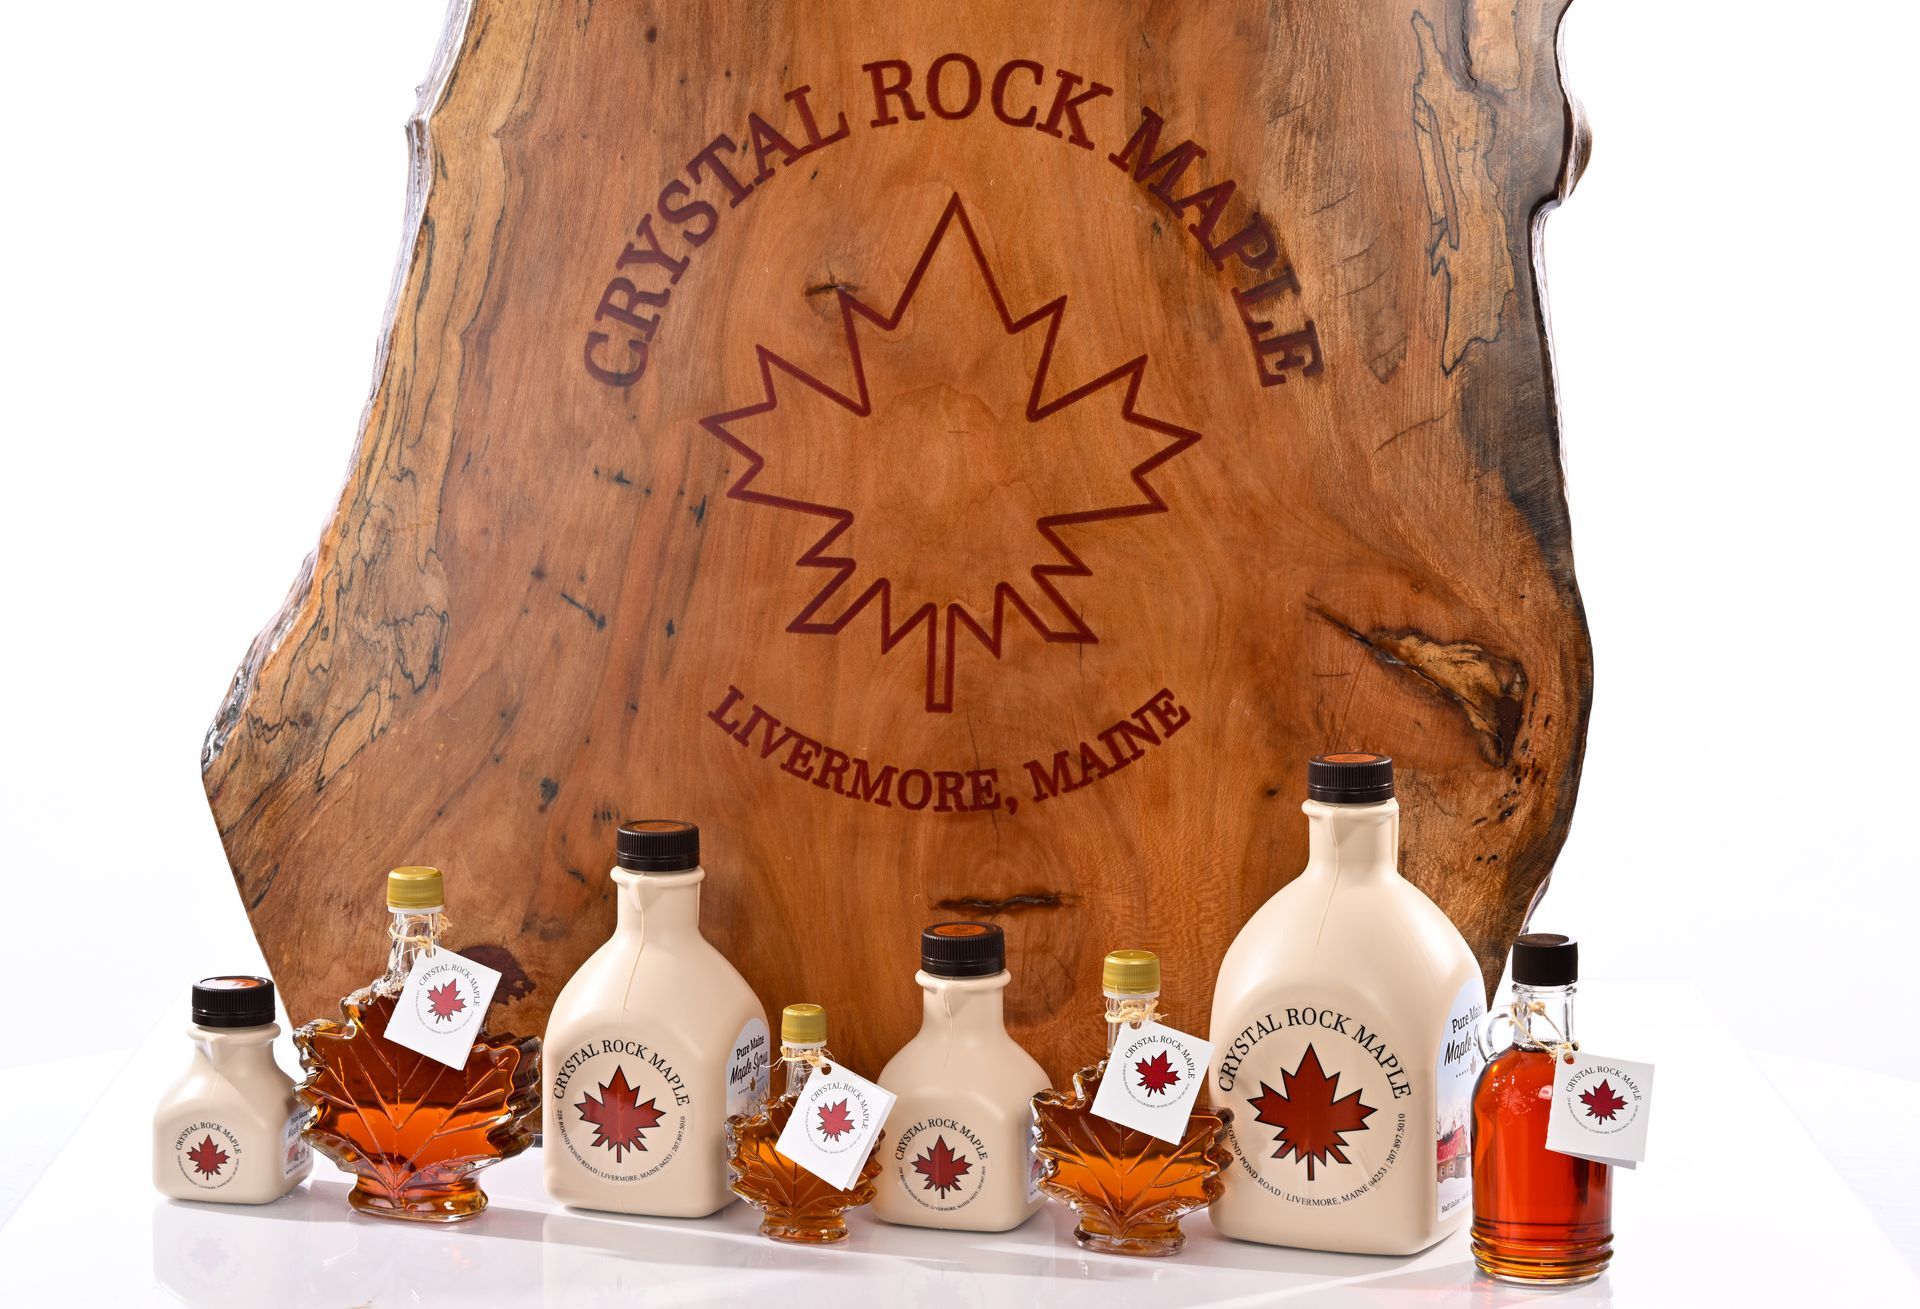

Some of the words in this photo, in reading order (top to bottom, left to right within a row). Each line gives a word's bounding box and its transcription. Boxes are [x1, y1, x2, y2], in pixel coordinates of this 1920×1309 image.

[583, 84, 850, 387] CRYSTAL
[861, 52, 1114, 150] ROCK
[1108, 106, 1324, 388] MAPLE
[707, 685, 1017, 815] LIVERMORE,
[1024, 687, 1191, 803] MAINE
[418, 964, 450, 986] CRYSTAL
[451, 964, 474, 980] ROCK
[469, 977, 481, 1007] MAPLE
[1451, 1013, 1469, 1034] Pure
[736, 1044, 750, 1061] Pure
[1124, 1035, 1159, 1059] CRYSTAL
[1160, 1035, 1184, 1051] ROCK
[1182, 1049, 1196, 1079] MAPLE
[1218, 1014, 1283, 1092] CRYSTAL
[1285, 1007, 1352, 1035] ROCK
[1352, 1024, 1412, 1100] MAPLE
[1444, 1030, 1472, 1067] Maple
[553, 1043, 600, 1100] CRYSTAL
[602, 1039, 649, 1060] ROCK
[648, 1052, 691, 1107] MAPLE
[729, 1057, 752, 1086] Maple
[1566, 1066, 1596, 1093] CRYSTAL
[1597, 1065, 1622, 1077] ROCK
[1621, 1074, 1642, 1101] MAPLE
[810, 1082, 842, 1102] CRYSTAL
[843, 1083, 863, 1100] ROCK
[859, 1099, 870, 1130] MAPLE
[175, 1123, 200, 1151] CRYSTAL
[200, 1121, 223, 1132] ROCK
[222, 1128, 242, 1155] MAPLE
[895, 1122, 927, 1161] CRYSTAL
[927, 1118, 960, 1131] ROCK
[960, 1125, 988, 1161] MAPLE
[1239, 1156, 1258, 1179] POND
[1257, 1177, 1281, 1196] ROAD
[1341, 1184, 1370, 1203] MAINE
[1368, 1167, 1388, 1187] 04253
[1386, 1113, 1406, 1165] 207.897.5010
[581, 1159, 598, 1174] ROAD
